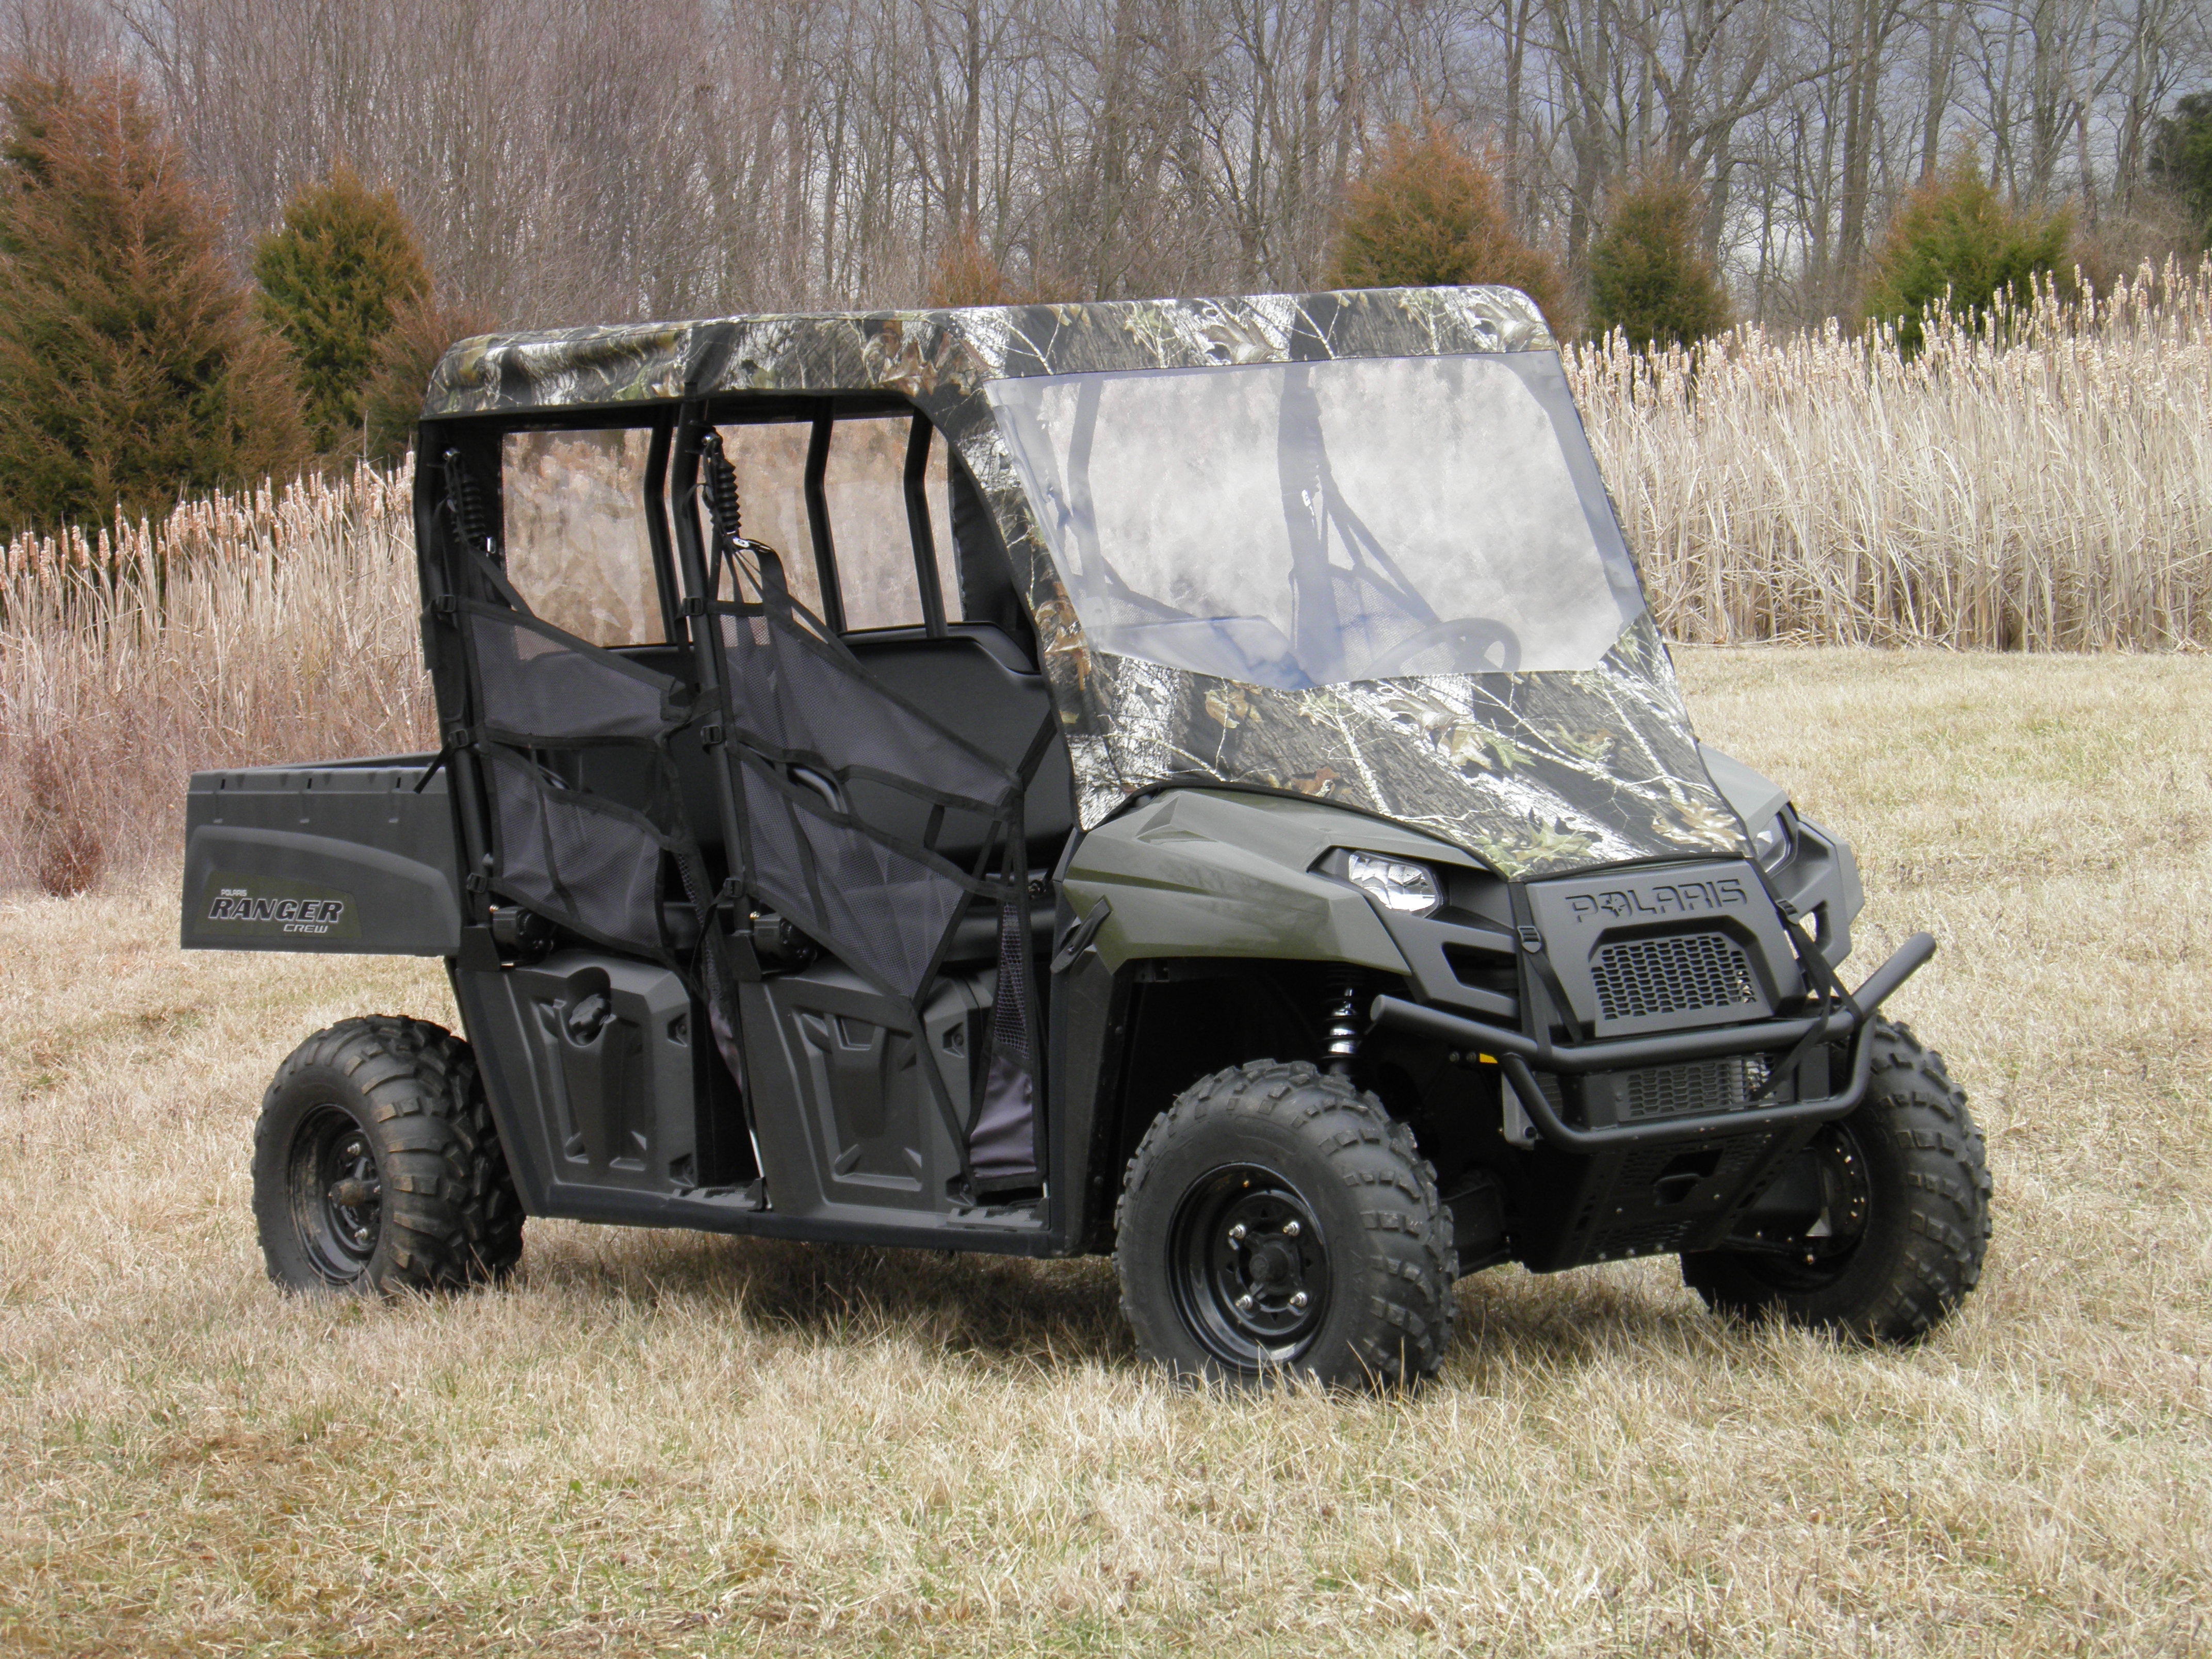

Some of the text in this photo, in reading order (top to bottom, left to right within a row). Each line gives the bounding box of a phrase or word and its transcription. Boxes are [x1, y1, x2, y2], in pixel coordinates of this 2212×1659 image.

[208, 897, 344, 923] RANGER
[1565, 879, 1747, 922] POLARIS
[283, 924, 328, 933] CREW
